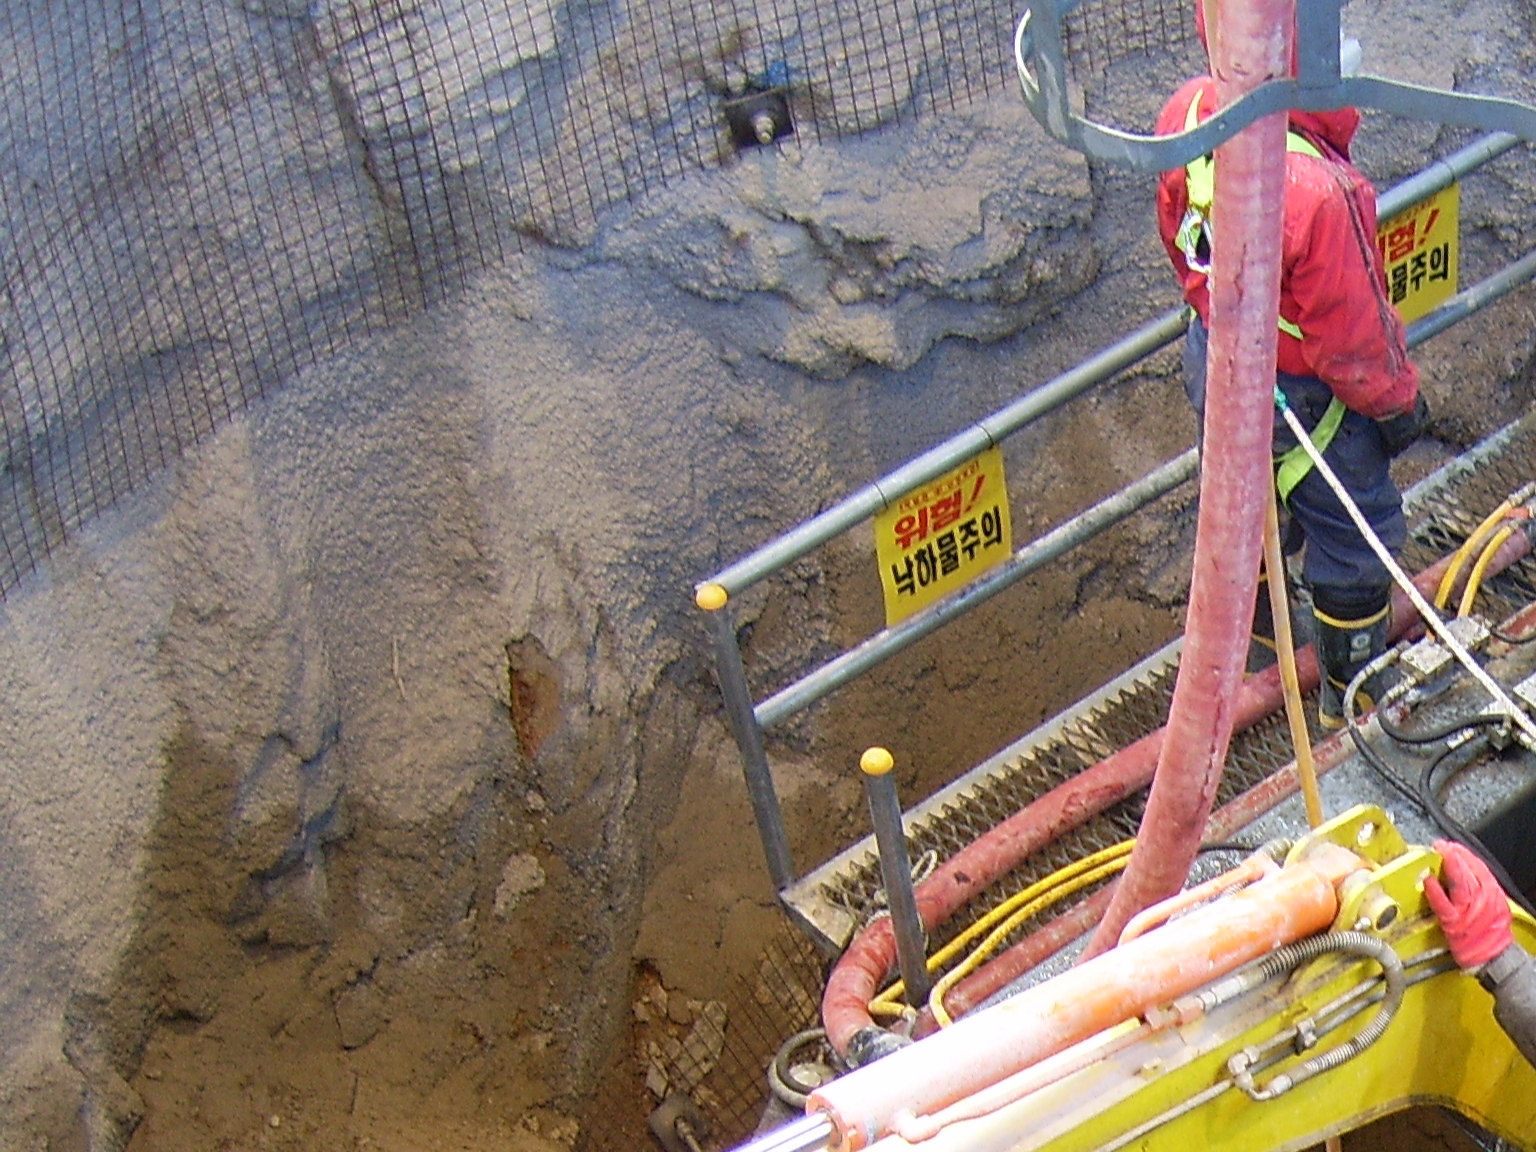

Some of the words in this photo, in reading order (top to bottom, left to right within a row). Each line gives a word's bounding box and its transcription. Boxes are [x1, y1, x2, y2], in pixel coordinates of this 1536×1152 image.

[1376, 208, 1440, 264] 험!
[1384, 242, 1448, 305] 물주의
[894, 473, 987, 551] 위험!
[891, 504, 1004, 597] 낙하물주의
